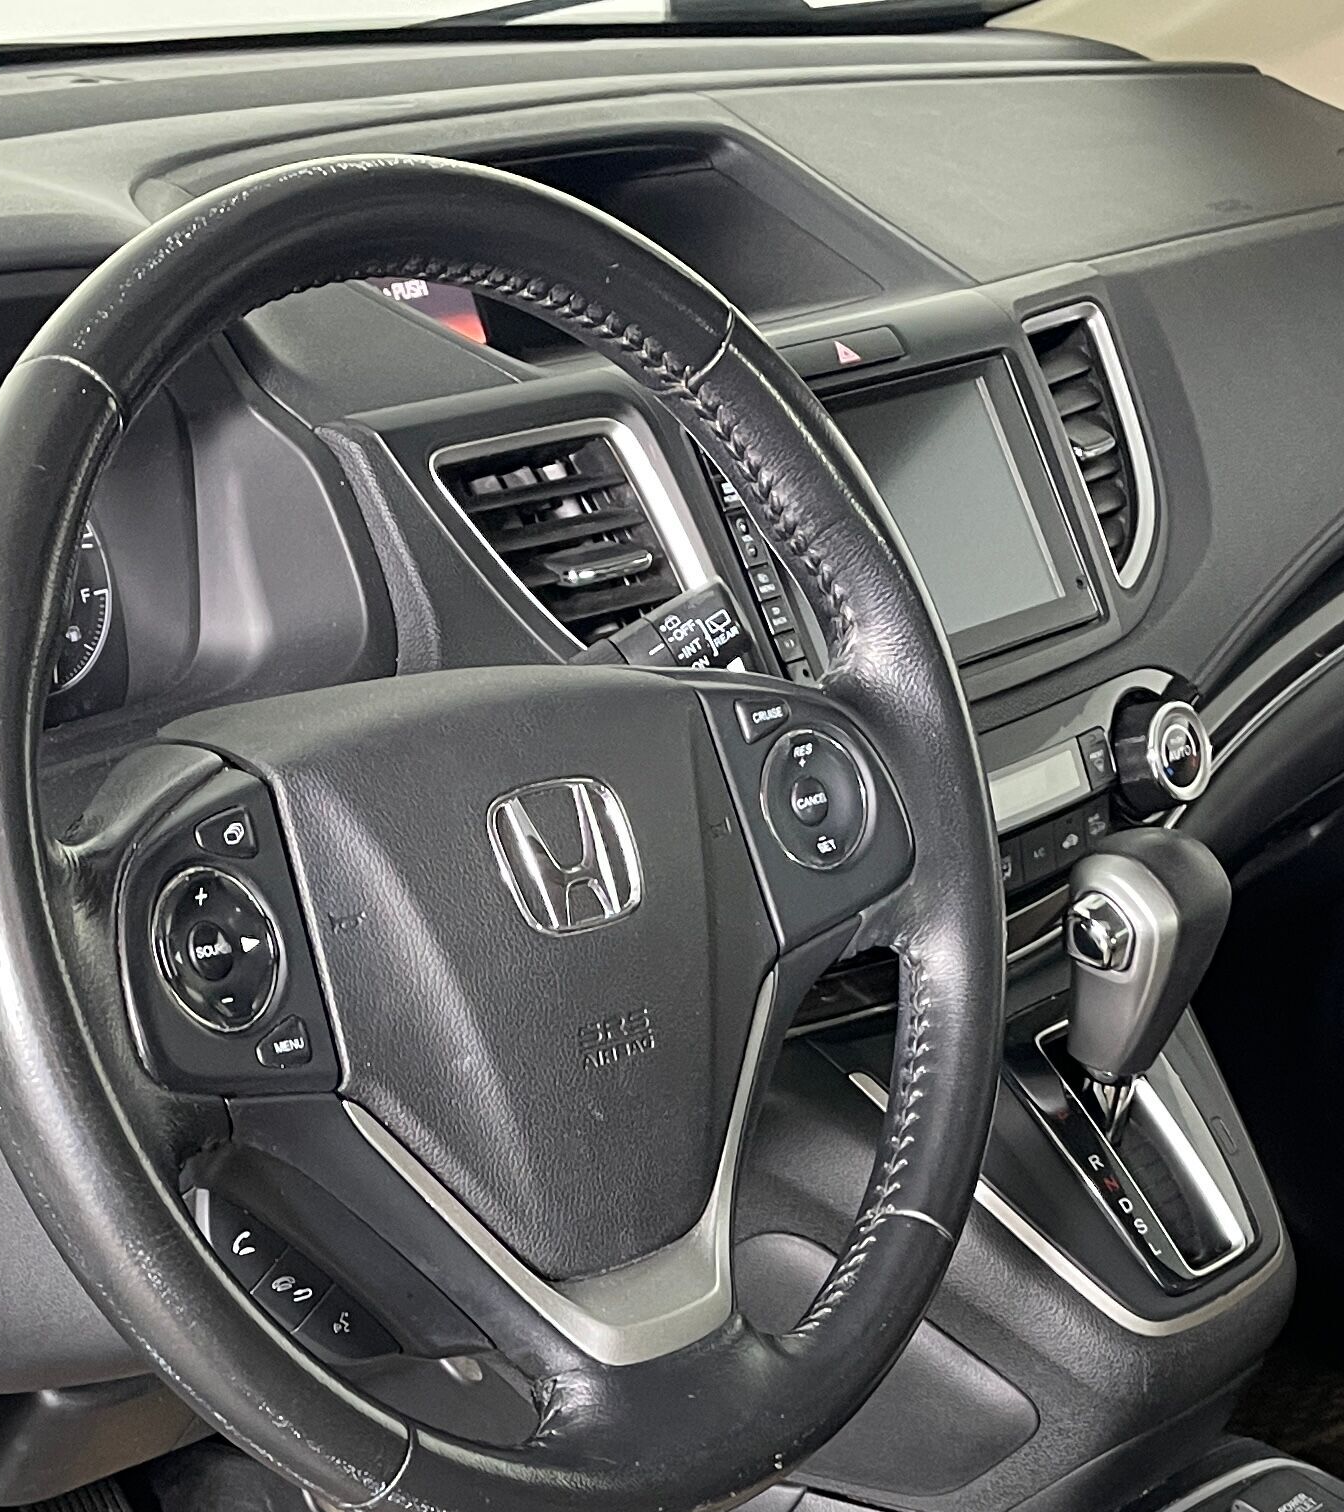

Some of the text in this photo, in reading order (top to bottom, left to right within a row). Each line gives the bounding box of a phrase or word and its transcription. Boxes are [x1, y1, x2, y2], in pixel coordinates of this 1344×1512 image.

[390, 278, 429, 301] PUSH
[79, 587, 91, 604] F
[672, 618, 696, 642] OFF
[713, 625, 740, 648] REAR
[681, 637, 702, 659] INT
[752, 706, 784, 724] CRUISE
[793, 742, 813, 758] RES
[1168, 744, 1192, 762] AUTO
[273, 1037, 305, 1054] MENU
[1087, 1154, 1104, 1171] R
[1103, 1175, 1120, 1192] N
[1118, 1197, 1134, 1214] D
[1133, 1218, 1148, 1235] S
